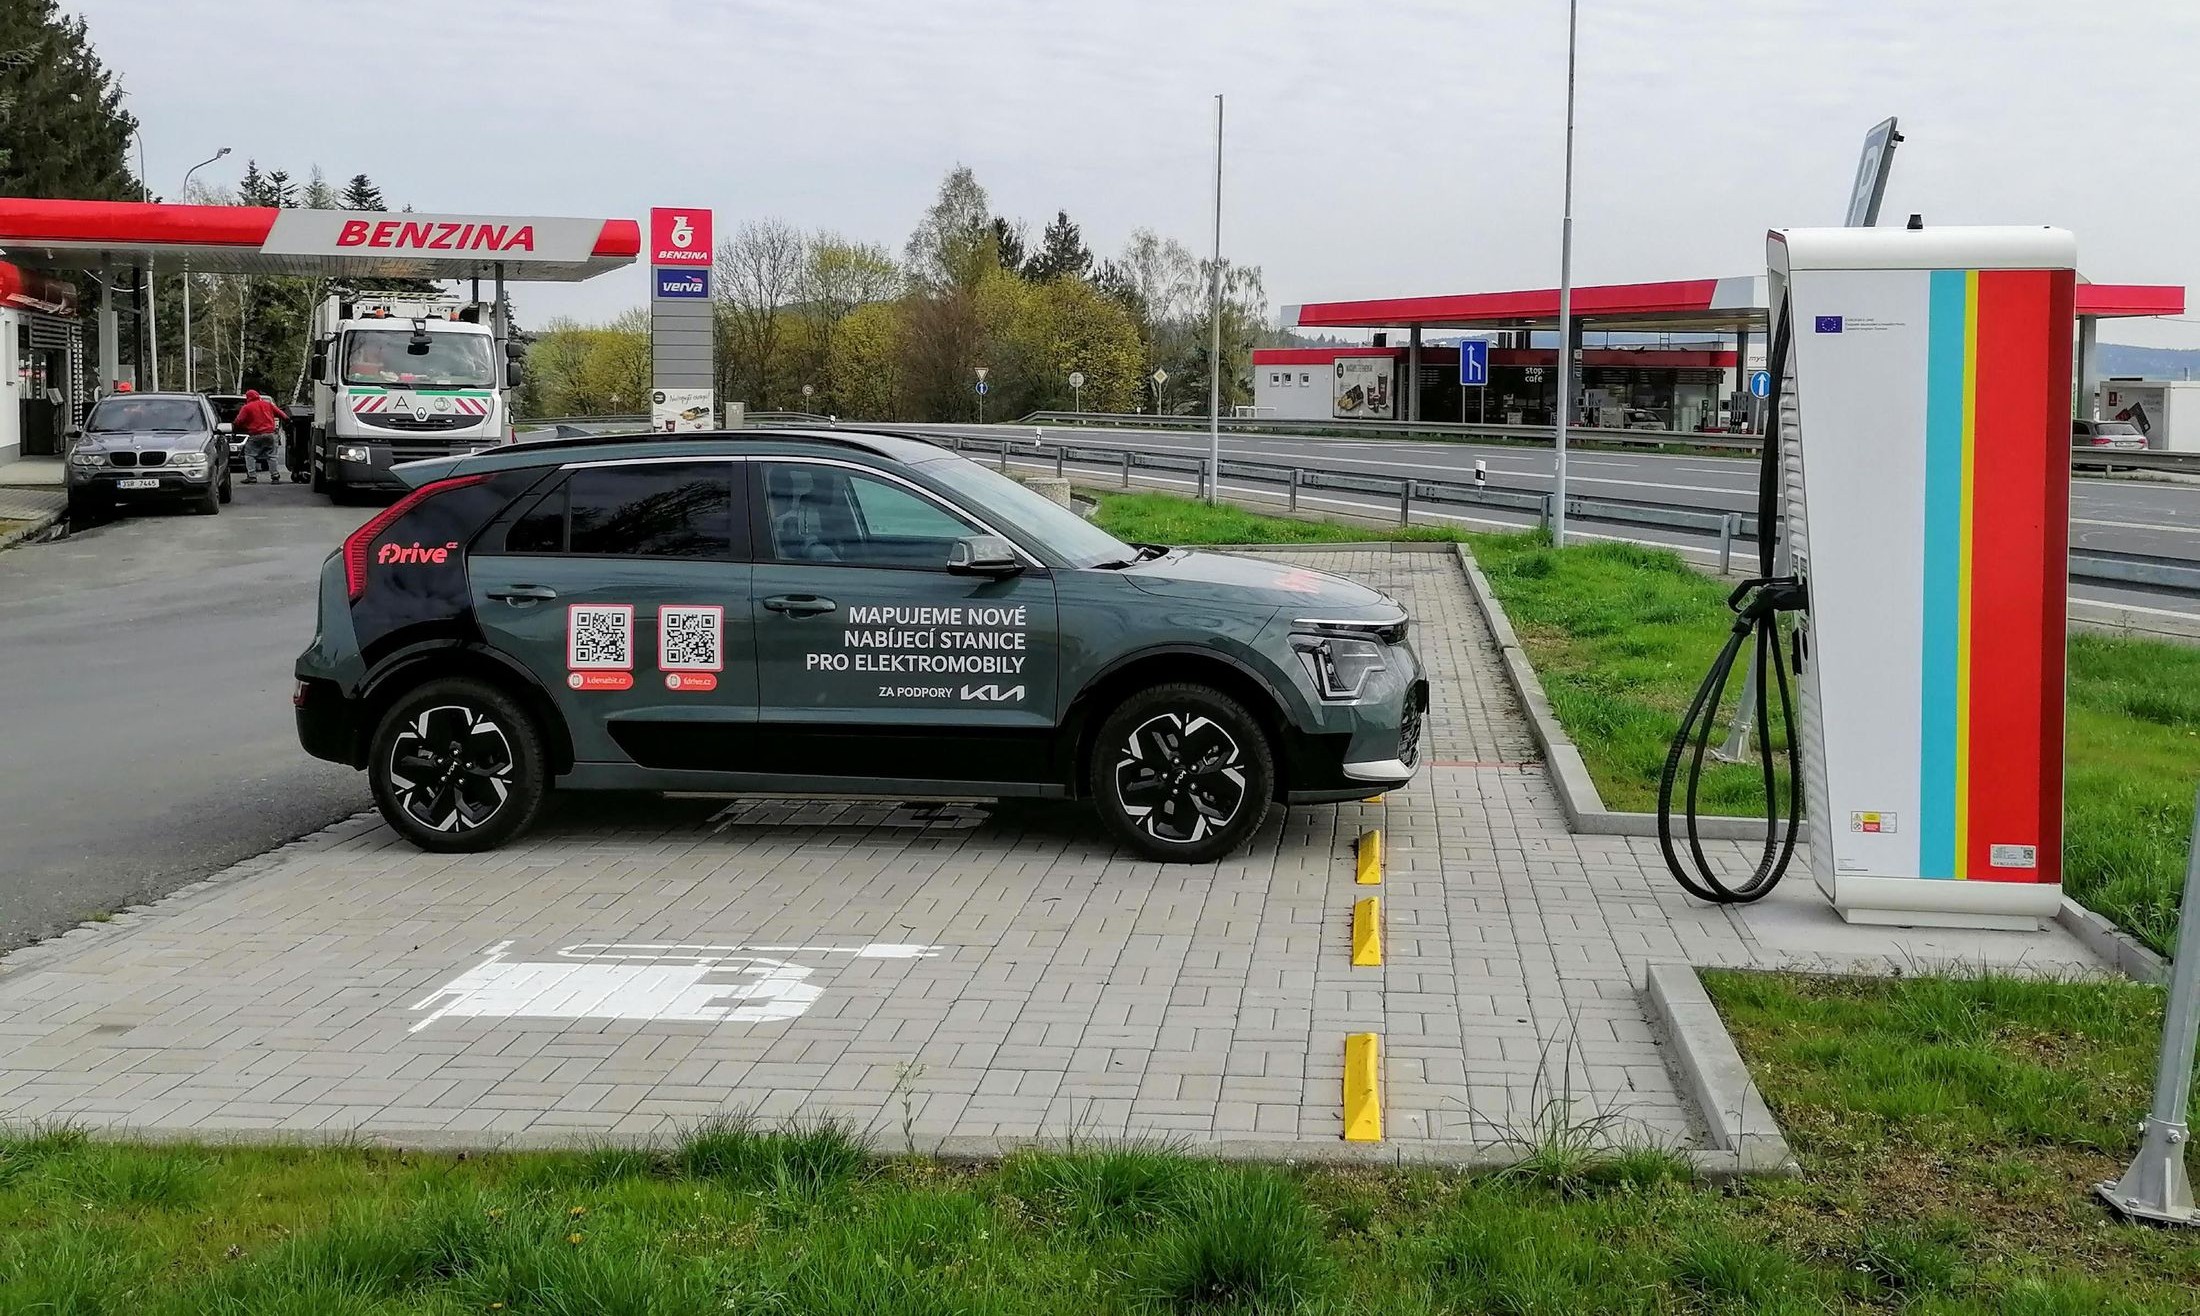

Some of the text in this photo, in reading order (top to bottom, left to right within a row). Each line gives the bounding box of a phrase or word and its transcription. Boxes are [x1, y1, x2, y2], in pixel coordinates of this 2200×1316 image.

[336, 220, 534, 251] BENZINA
[658, 251, 708, 260] BENZINA
[662, 282, 703, 292] verva
[1524, 374, 1543, 383] cafe
[394, 395, 409, 410] A
[378, 542, 448, 564] fDrive
[849, 605, 1026, 626] MAPUJEME NOVÉ
[844, 627, 1026, 650] NABÍJECÍ STANICE
[806, 653, 1026, 673] PRO ELEKTROMOBILY
[879, 684, 1025, 701] ZA PODPORY KIA
